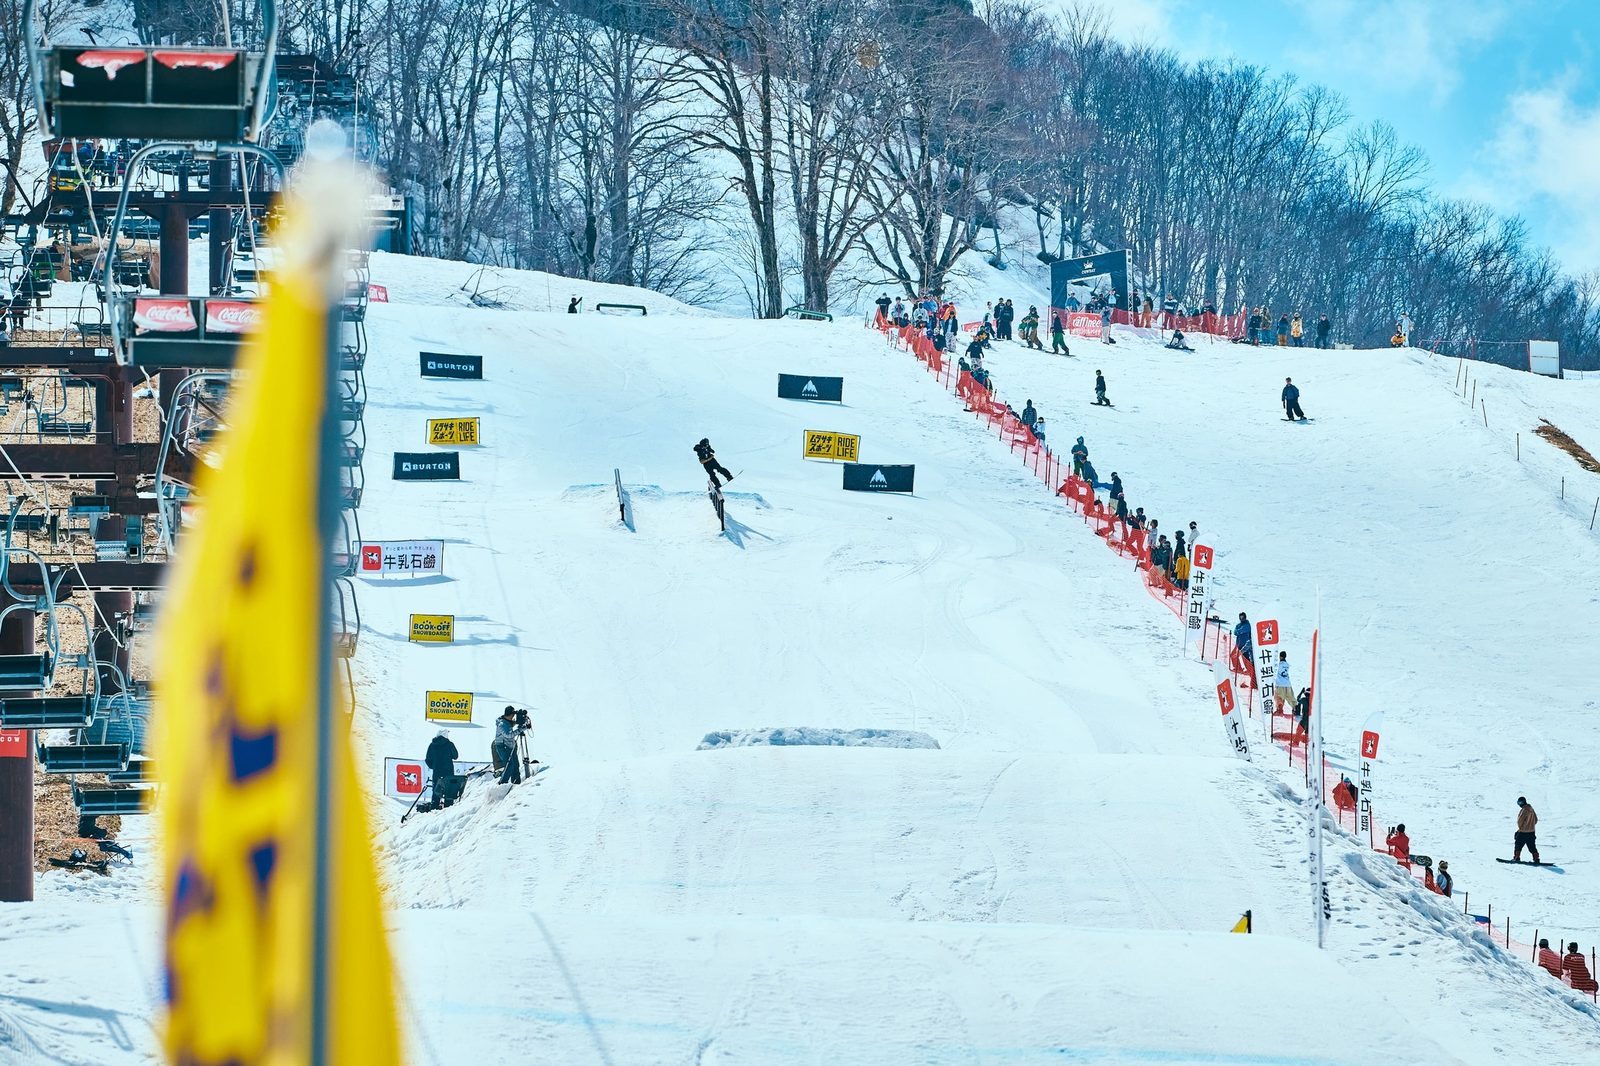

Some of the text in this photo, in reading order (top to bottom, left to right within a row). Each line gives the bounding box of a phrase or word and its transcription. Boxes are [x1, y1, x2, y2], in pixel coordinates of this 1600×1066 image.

[437, 363, 475, 372] BURTON
[434, 422, 455, 431] ムラサキ
[458, 421, 474, 432] RIDE
[434, 431, 455, 440] スポーツ
[459, 432, 475, 442] LIFE
[809, 434, 833, 444] ムラサキ
[837, 436, 855, 449] RIDE
[809, 443, 832, 452] スポーツ
[837, 447, 854, 458] LIFE
[412, 463, 451, 471] BURTON
